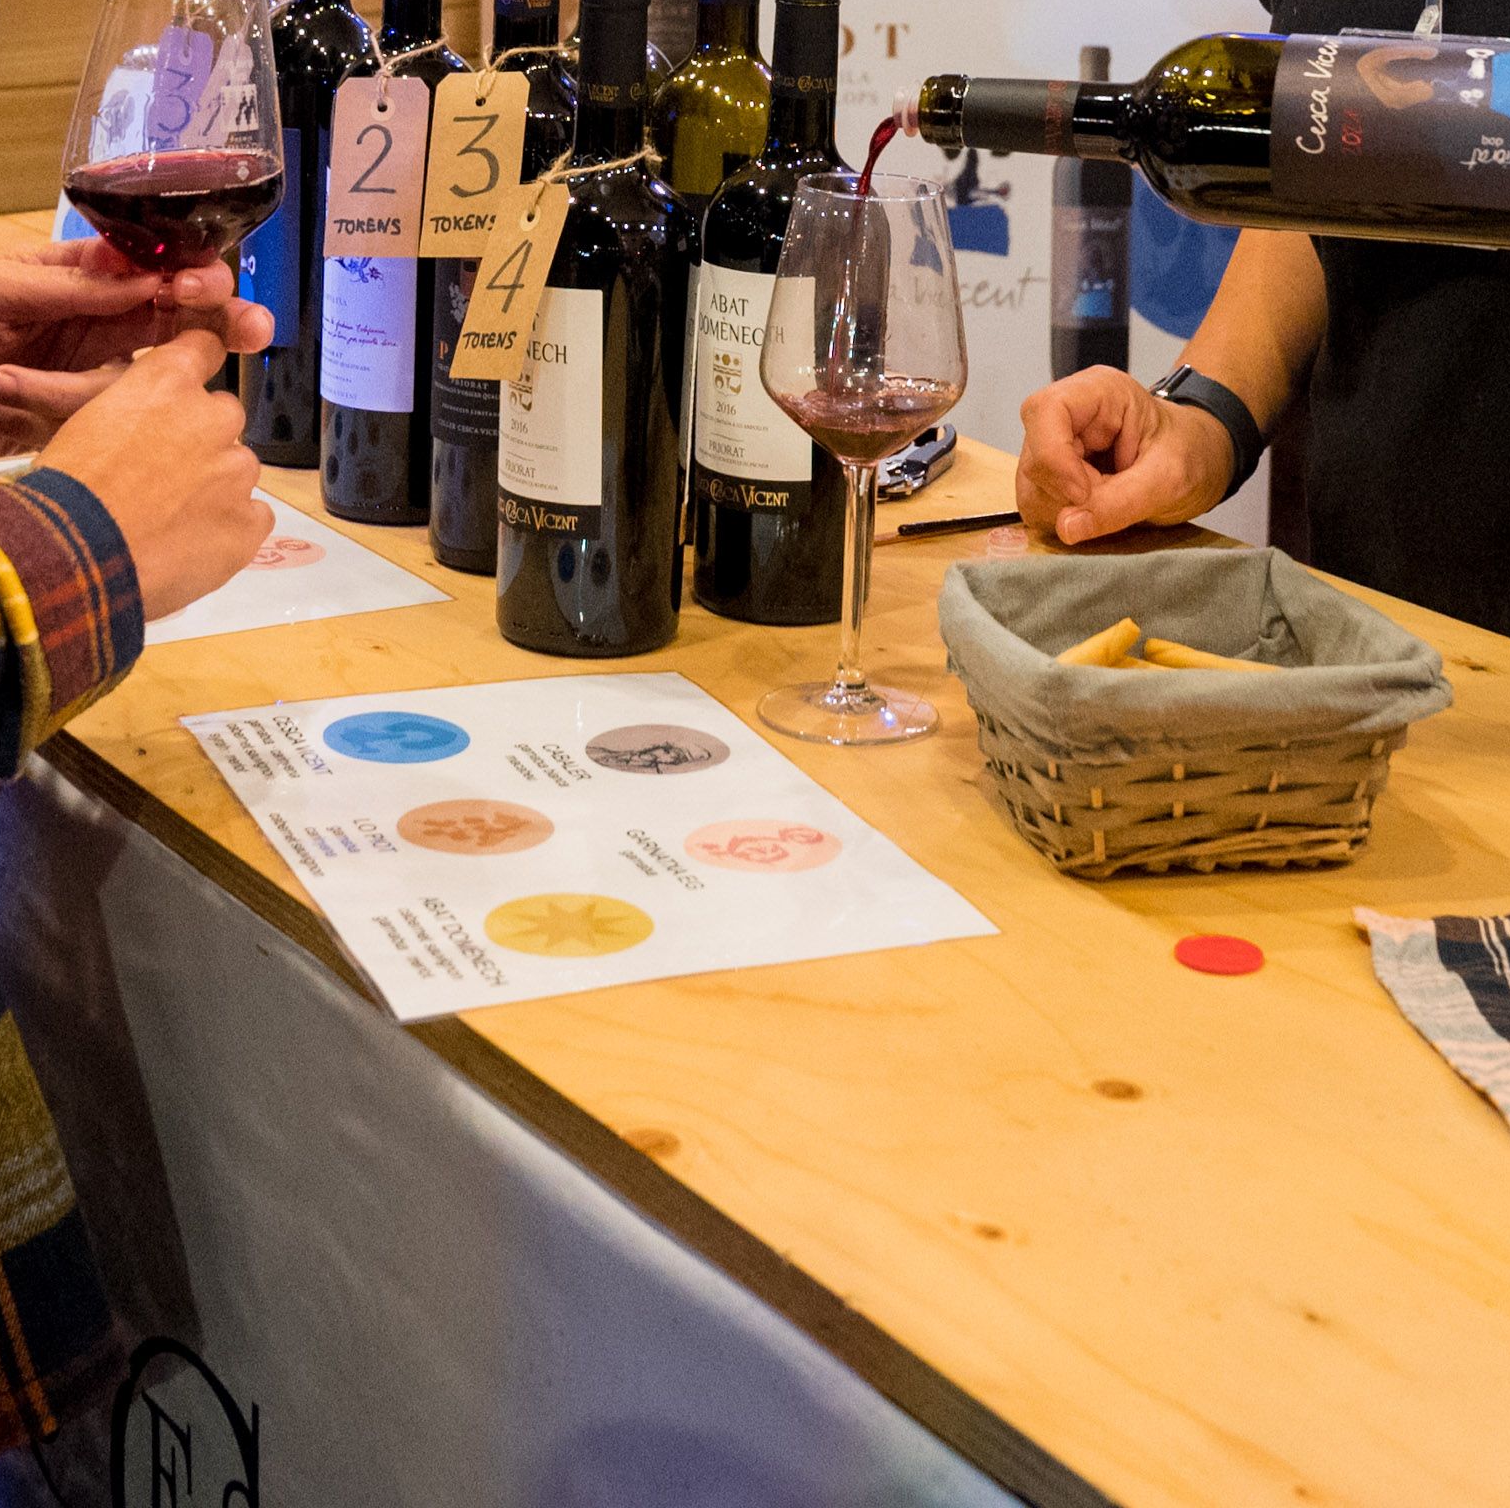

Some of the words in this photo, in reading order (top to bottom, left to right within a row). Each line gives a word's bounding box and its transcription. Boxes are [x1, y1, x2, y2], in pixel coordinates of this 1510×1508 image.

[1294, 85, 1331, 156] Cesca
[349, 124, 396, 194] 2
[449, 113, 500, 199] 3
[333, 216, 401, 236] TOKENS
[486, 239, 534, 314] 4
[710, 292, 749, 318] ABAT
[462, 330, 518, 351] TOKENS
[715, 399, 738, 417] 2016
[511, 418, 529, 434] 2016
[708, 439, 746, 459] PRIORAT
[505, 459, 537, 479] PRIORAT
[741, 483, 790, 510] VICENT
[531, 505, 579, 532] VICENT
[272, 716, 306, 746] CESCA
[541, 744, 593, 781] CABALER
[352, 819, 378, 832] LO
